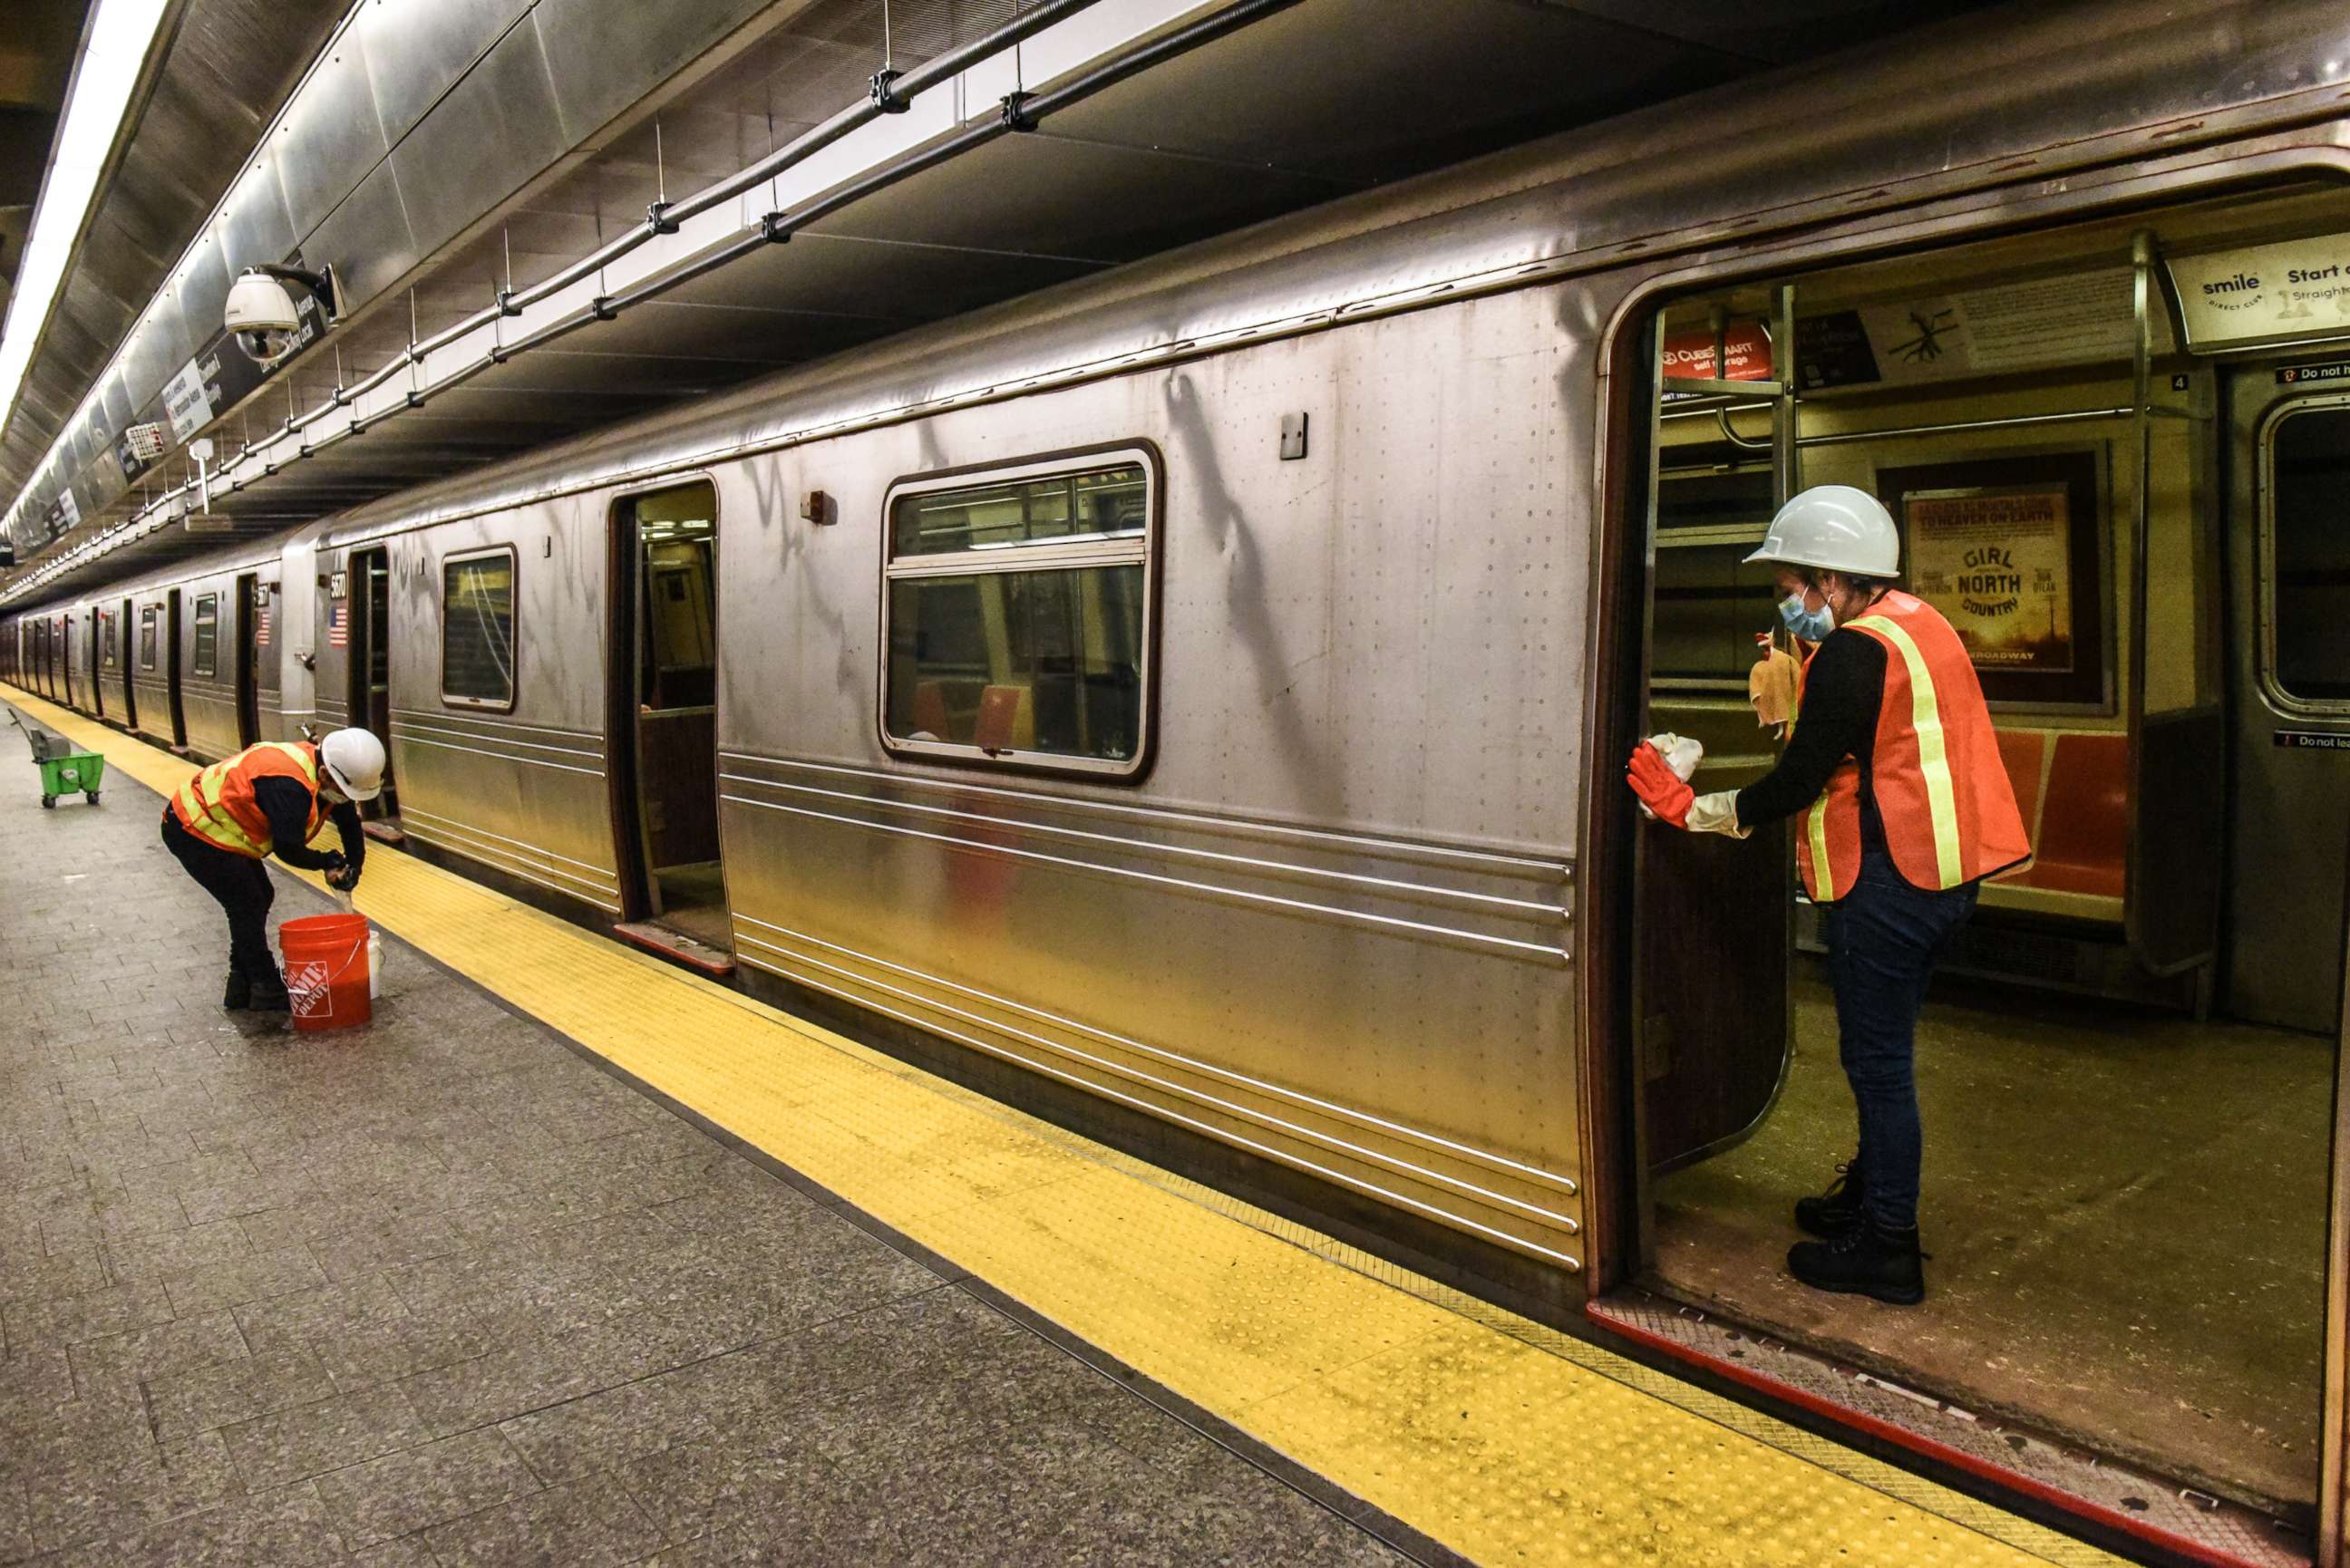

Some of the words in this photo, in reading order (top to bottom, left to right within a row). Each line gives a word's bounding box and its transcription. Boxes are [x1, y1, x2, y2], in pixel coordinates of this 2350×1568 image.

[2287, 264, 2339, 284] Start
[2203, 274, 2260, 295] smile
[2209, 299, 2240, 311] DIRECT
[2244, 294, 2264, 309] CLUB
[2302, 368, 2317, 379] Do
[2321, 365, 2341, 377] not
[2175, 377, 2184, 389] 4
[1938, 511, 1986, 527] HEAVEN
[2010, 508, 2054, 523] EARTH
[1963, 547, 2014, 569] GIRL
[1957, 574, 2021, 594] NORTH
[1962, 596, 2019, 617] COUNTRY
[2299, 736, 2316, 746] Do
[2316, 738, 2335, 748] not
[299, 983, 328, 1016] DEPOT
